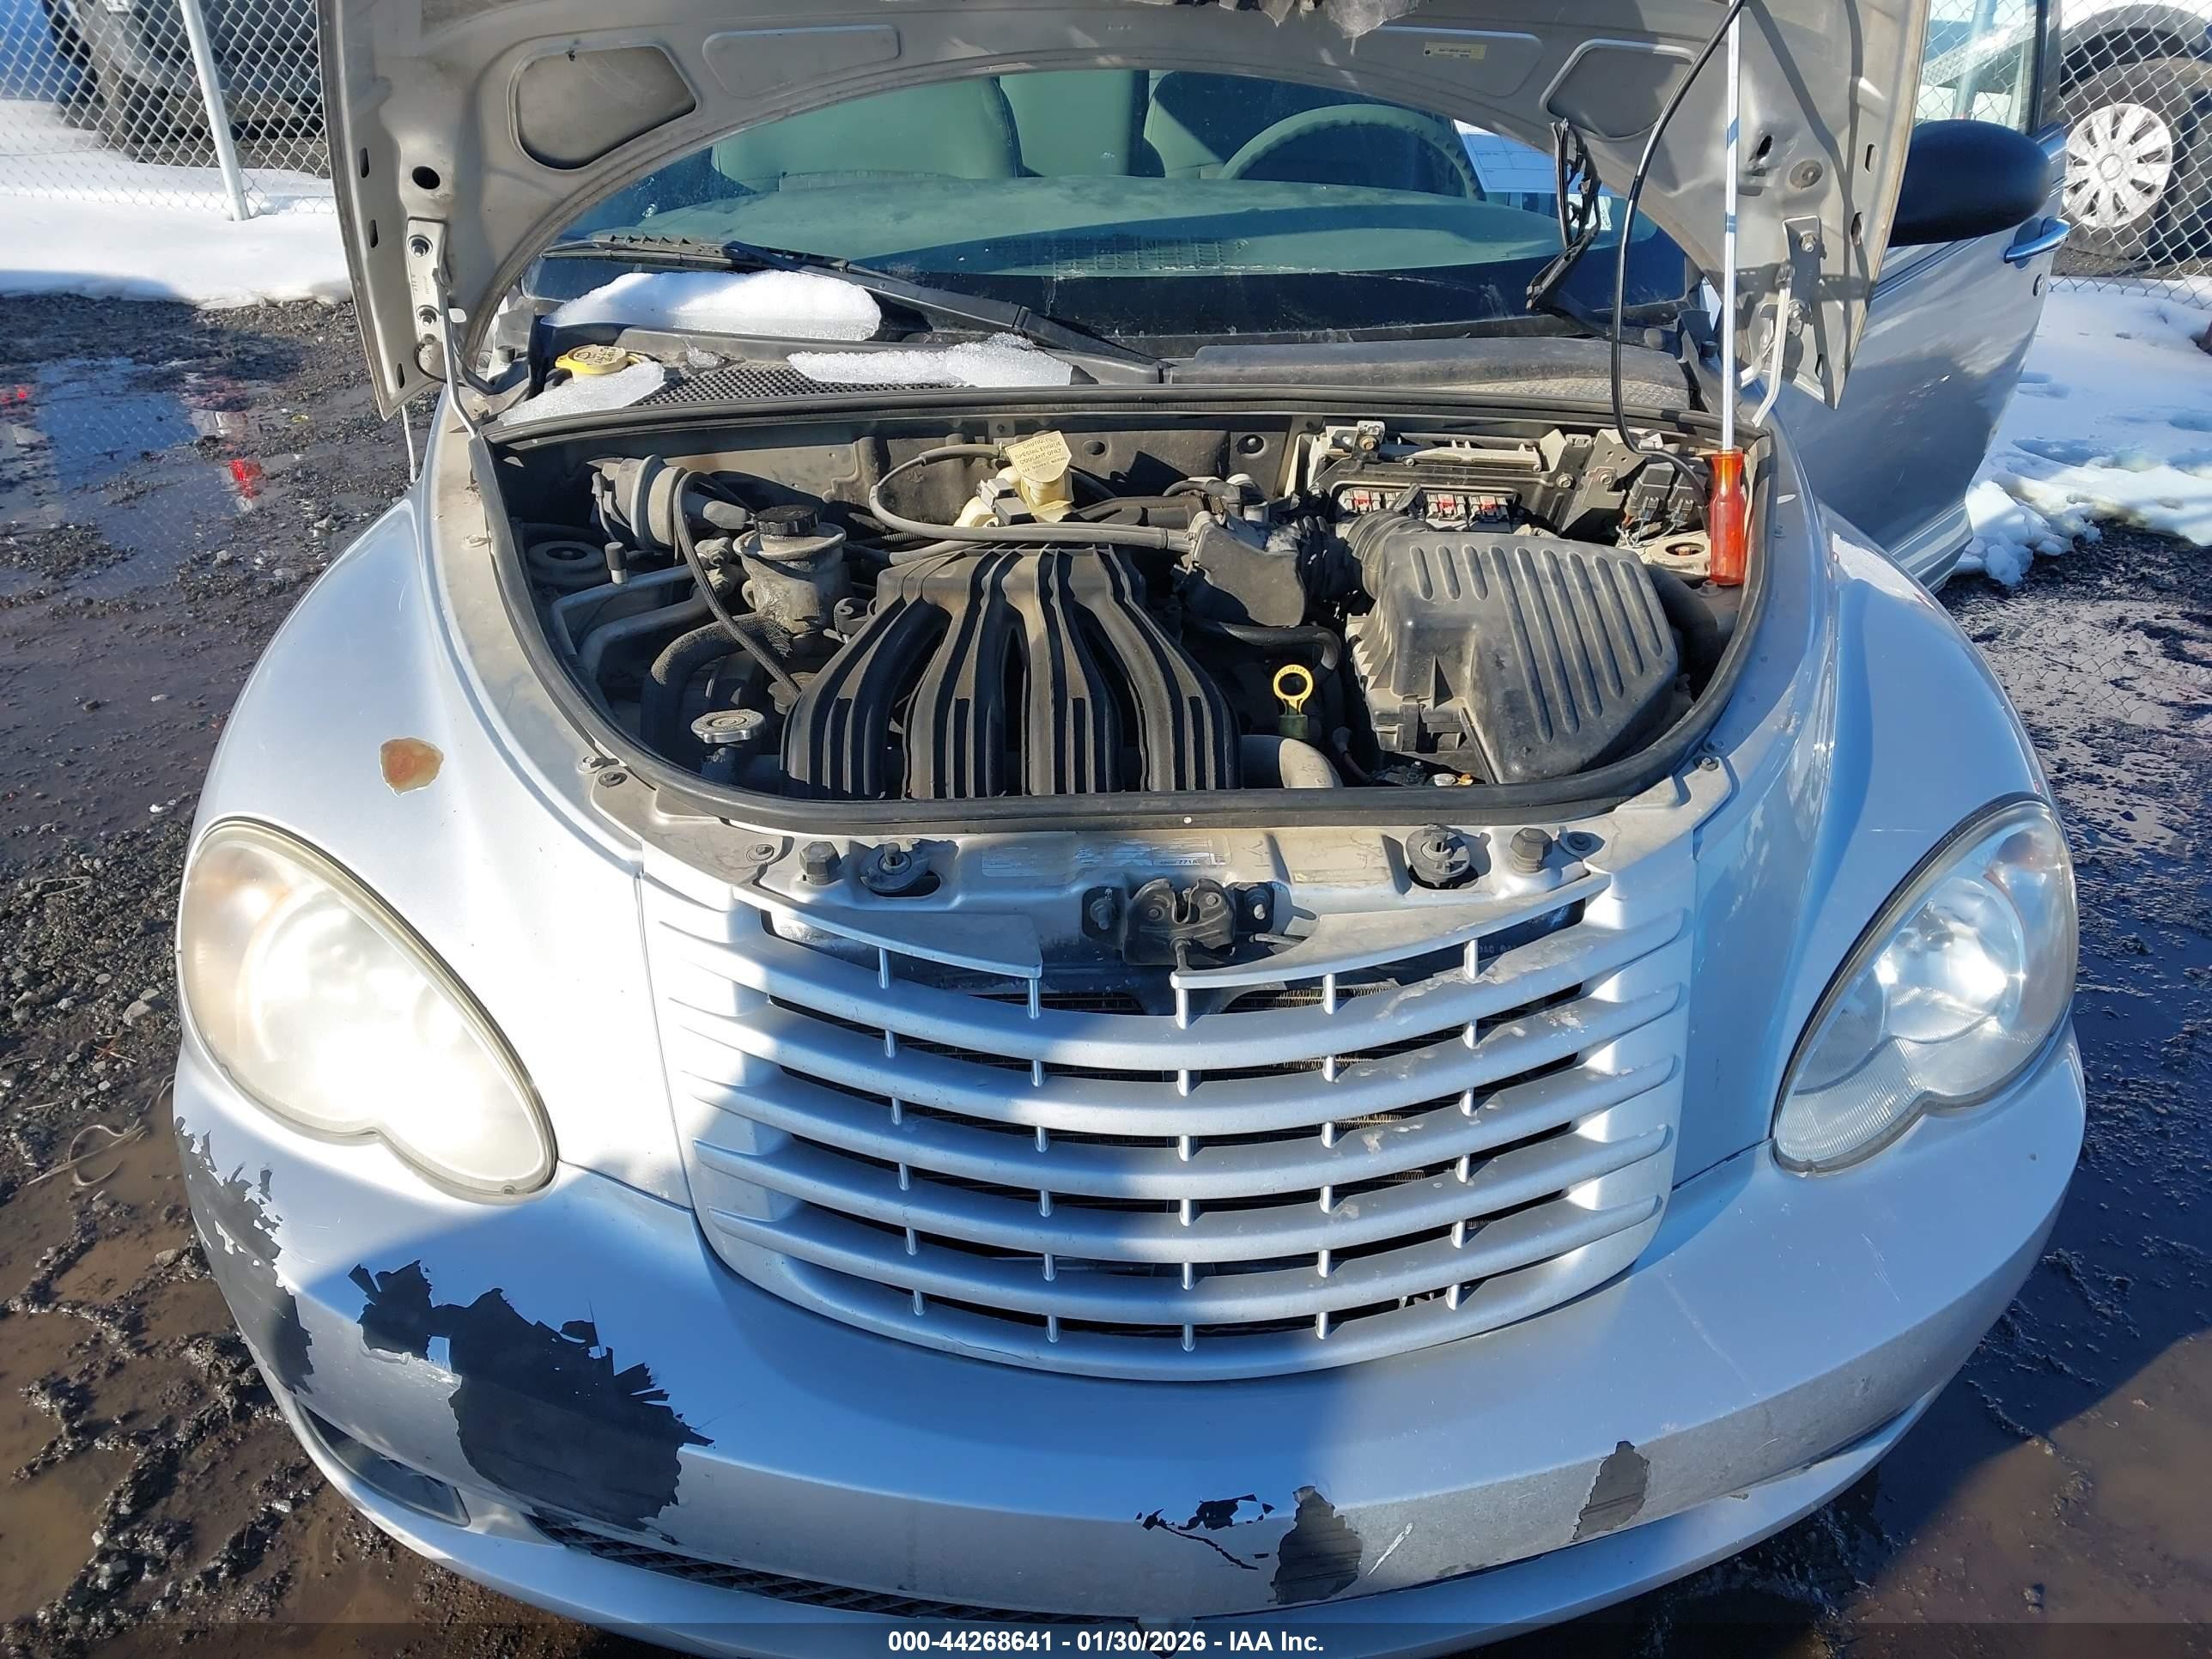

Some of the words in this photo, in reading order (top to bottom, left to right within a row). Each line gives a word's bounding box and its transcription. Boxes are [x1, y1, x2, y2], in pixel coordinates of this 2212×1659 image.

[1015, 449, 1039, 460] SPECIAL
[1039, 441, 1062, 452] ENGINE
[1019, 453, 1046, 465] COOLANT
[1047, 447, 1061, 457] ONLY
